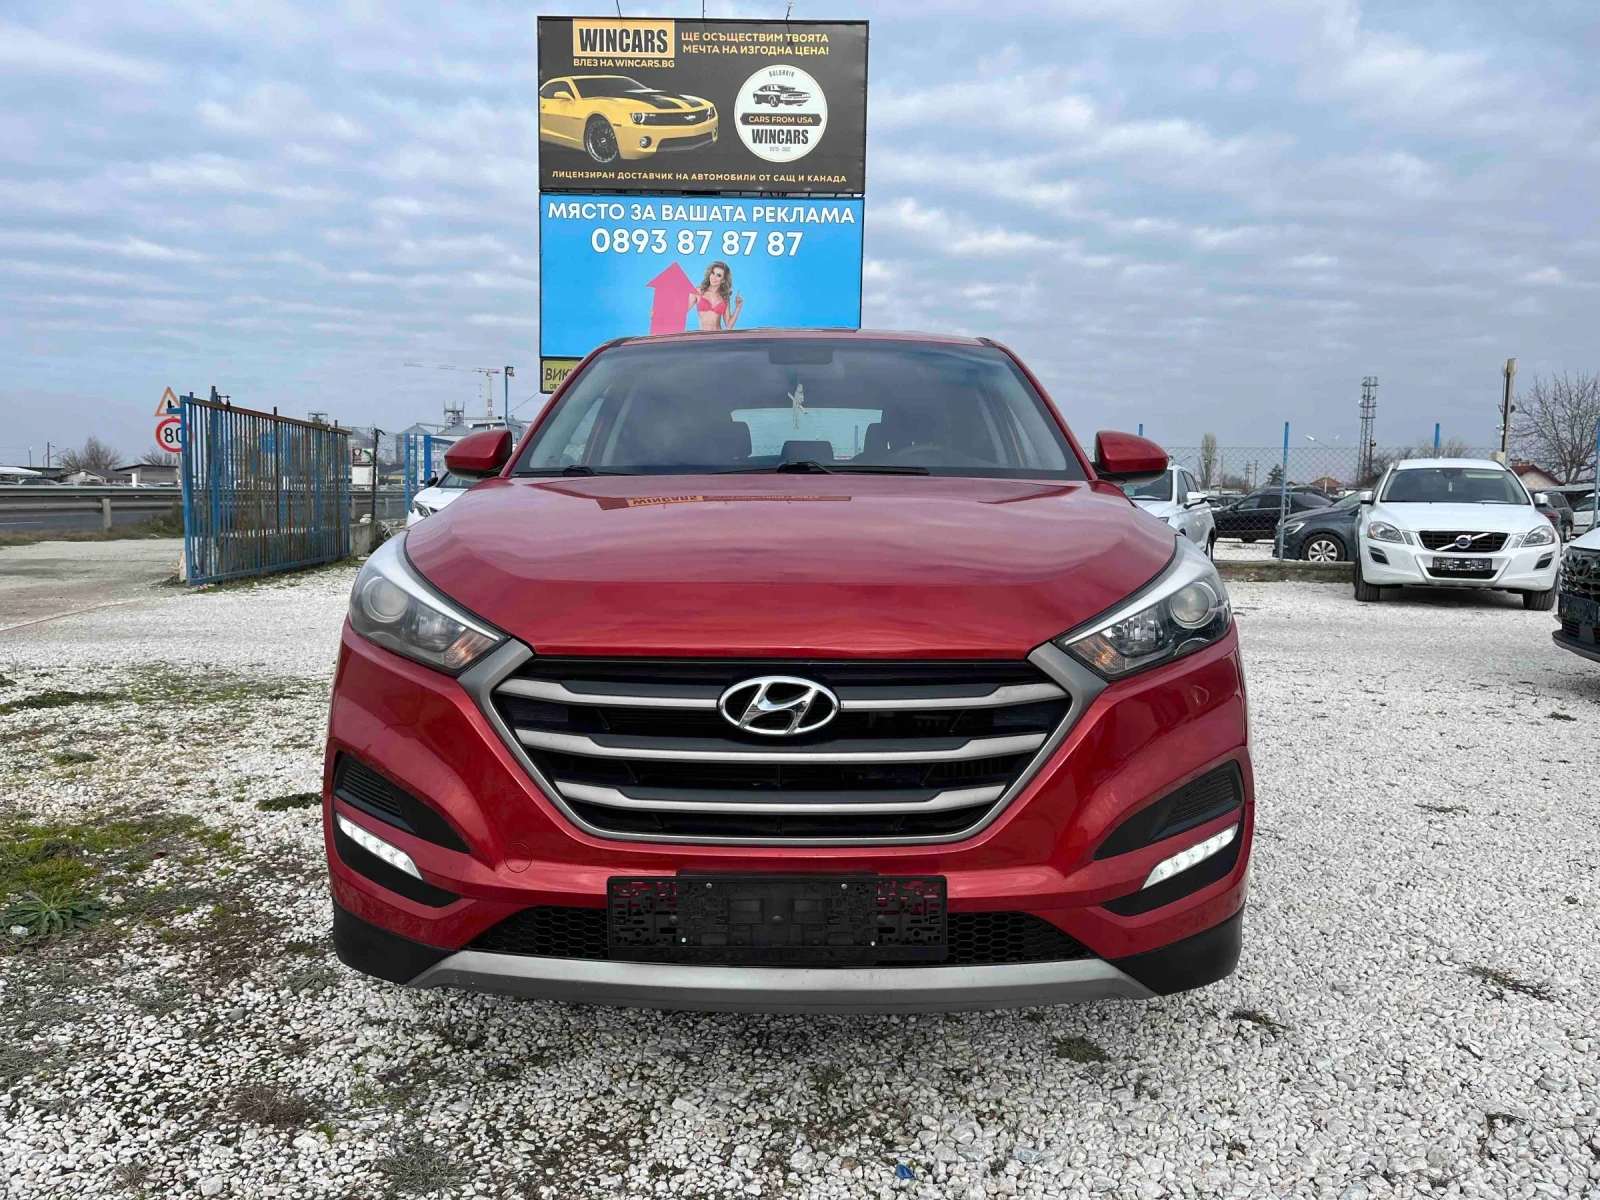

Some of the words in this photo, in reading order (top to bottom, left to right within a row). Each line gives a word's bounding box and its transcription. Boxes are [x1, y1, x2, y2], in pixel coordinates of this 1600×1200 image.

[578, 28, 668, 54] WINCARS
[681, 32, 700, 43] ЩЕ
[702, 32, 783, 43] ОСЪЩЕСТВИМ
[785, 33, 829, 43] ТВОЯТА
[682, 44, 720, 54] МЕЧТА
[722, 45, 738, 54] НА
[740, 45, 793, 56] ИЗГОДНА
[794, 46, 829, 56] ЦЕНА!
[573, 59, 598, 67] ВЛЕЗ
[600, 59, 615, 67] НА
[615, 59, 675, 69] WINCARS.BG
[771, 116, 795, 124] FROM
[796, 116, 814, 124] USA
[751, 128, 809, 145] WINCARS
[552, 170, 615, 179] ЛИЦЕНЗИРАН
[617, 172, 673, 180] ДОСТАВЧИК
[690, 173, 756, 181] АВТОМОБИЛИ
[773, 174, 796, 183] САЩ
[807, 174, 847, 183] КАНАДА
[547, 202, 626, 220] МЯСТО
[630, 204, 657, 221] ЗА
[661, 204, 747, 222] ВАШАТА
[752, 206, 855, 224] РЕКЛАМА
[591, 227, 668, 254] 0893
[676, 229, 714, 255] 87
[721, 230, 759, 256] 87
[766, 231, 804, 257] 87
[545, 367, 573, 381] ВИК
